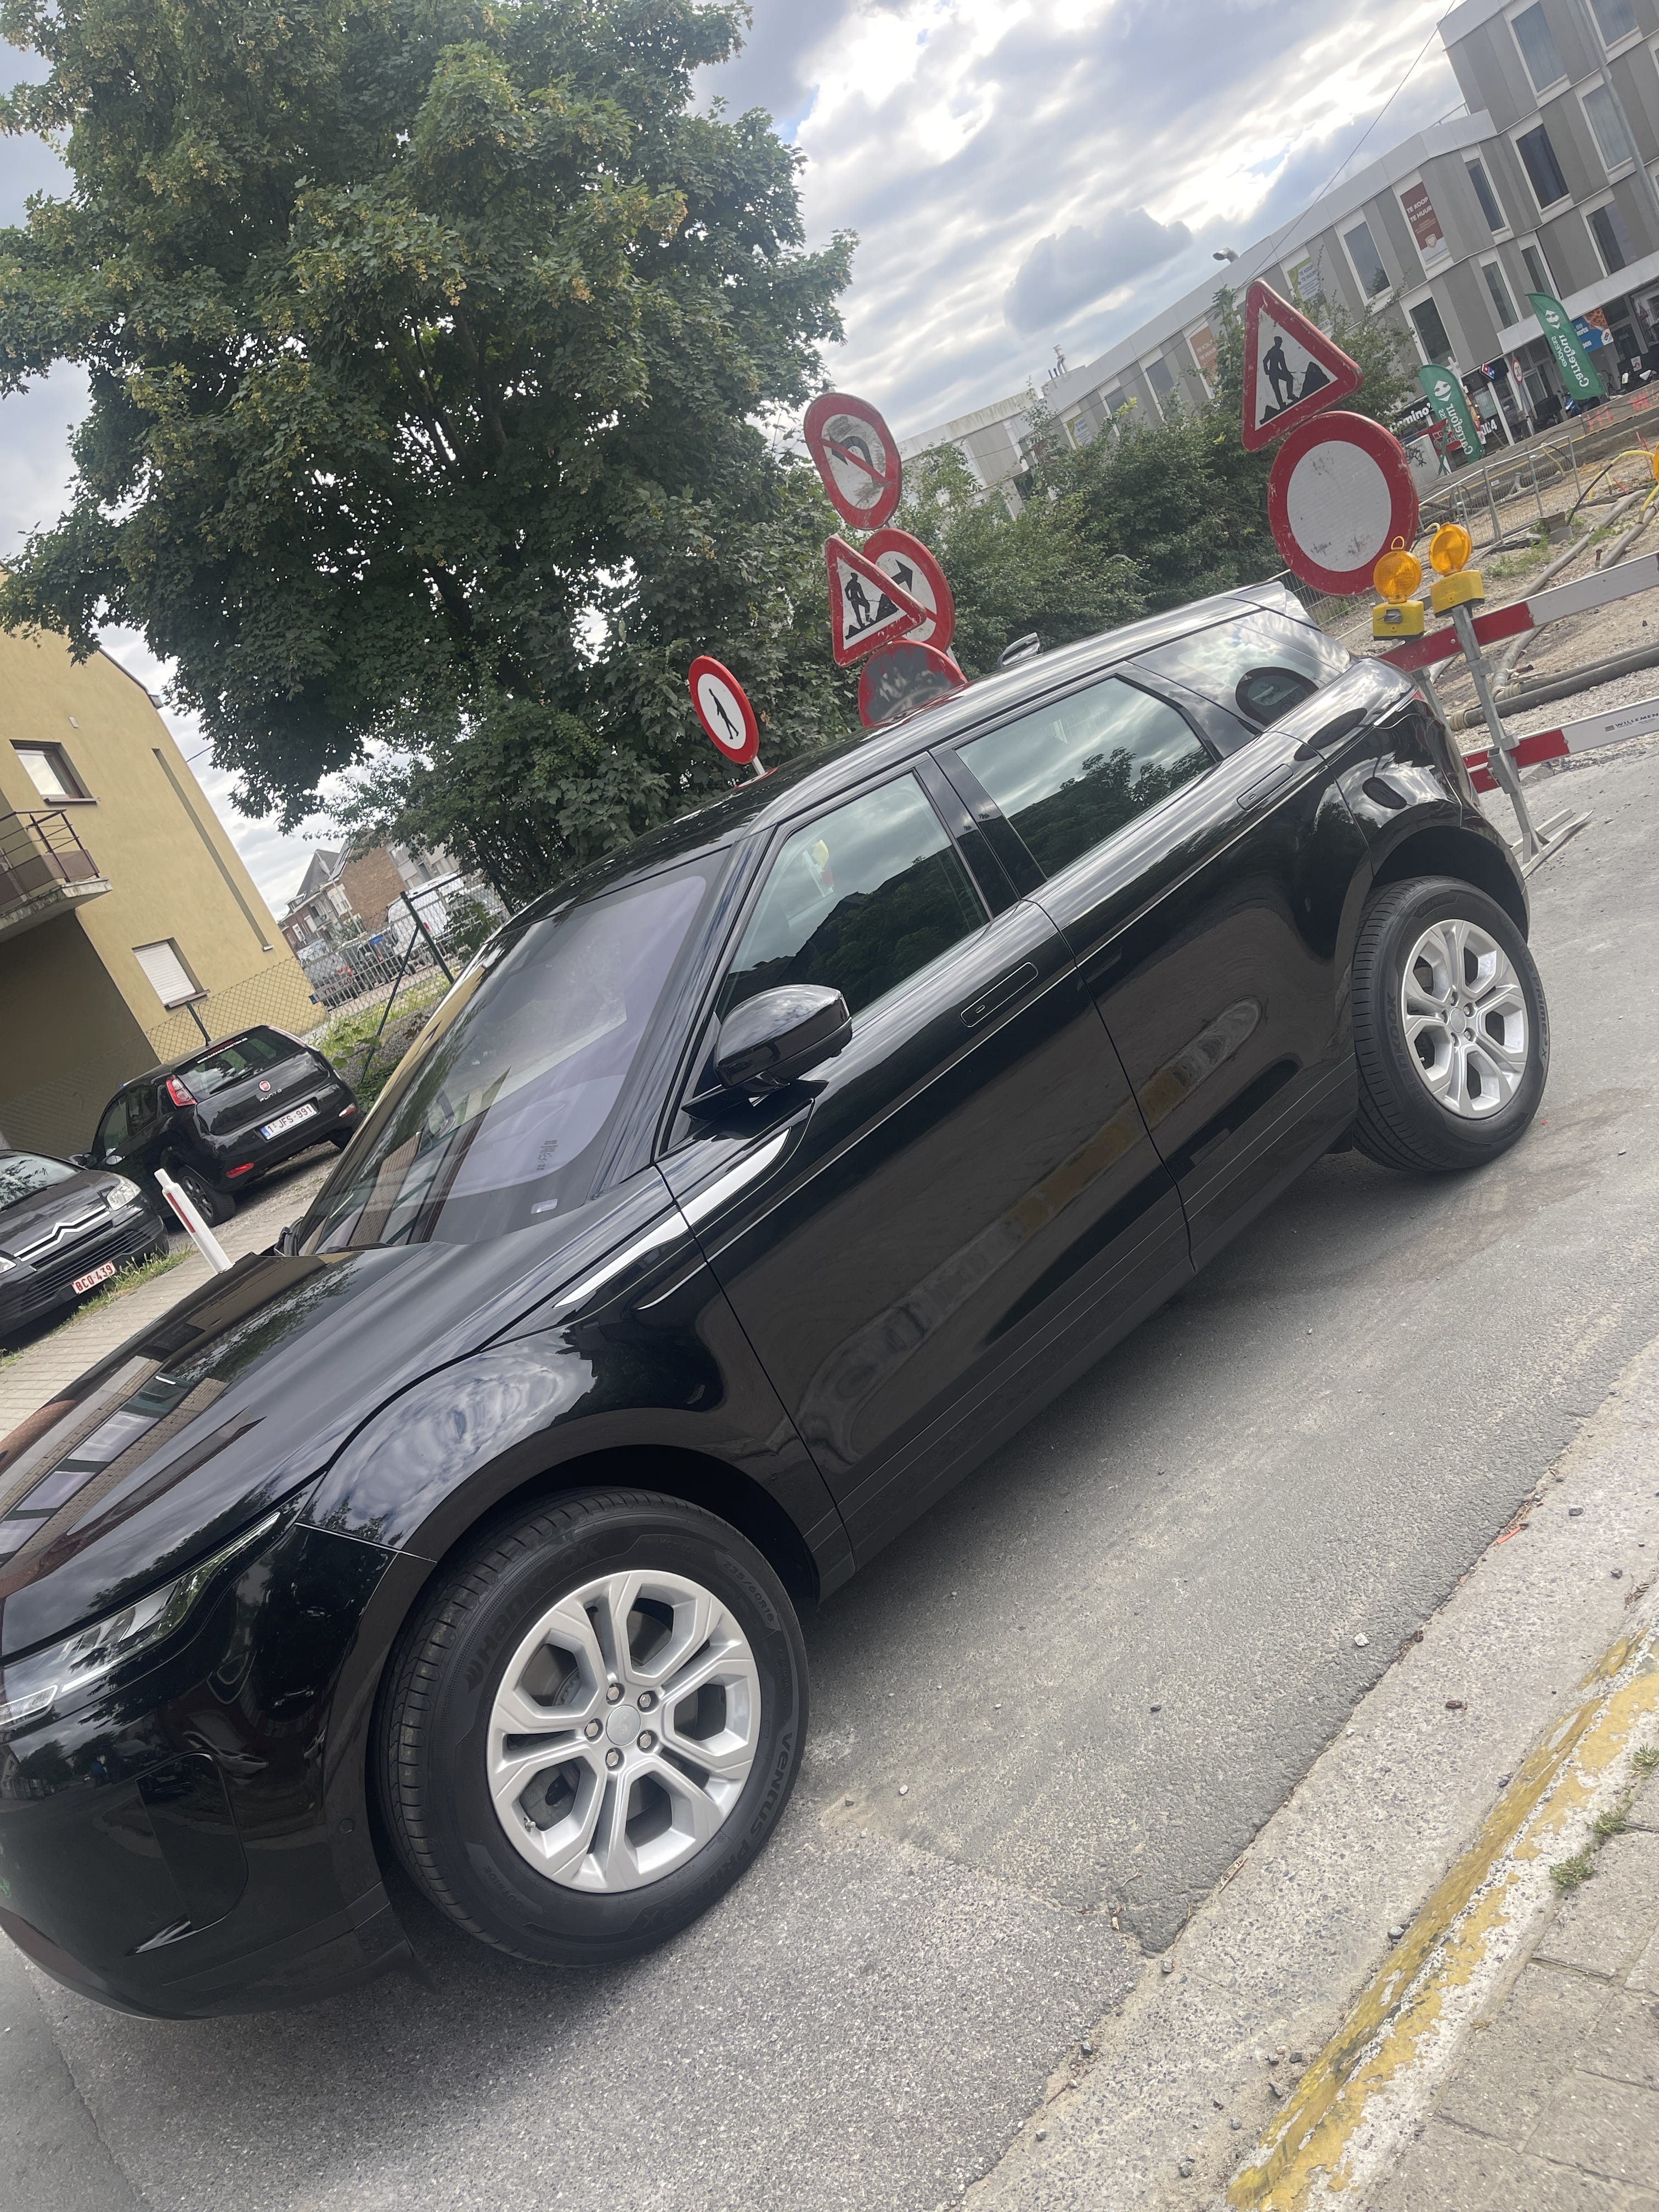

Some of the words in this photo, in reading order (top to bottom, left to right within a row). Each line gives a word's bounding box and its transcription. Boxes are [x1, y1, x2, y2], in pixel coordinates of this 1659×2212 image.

[1414, 196, 1429, 209] KOOP
[1417, 205, 1432, 218] HUUR
[1615, 713, 1658, 728] WILLEMEN
[259, 1088, 282, 1102] PUNTO
[268, 1105, 312, 1133] 1-JFS-991
[723, 1561, 774, 1622] 235/60R18
